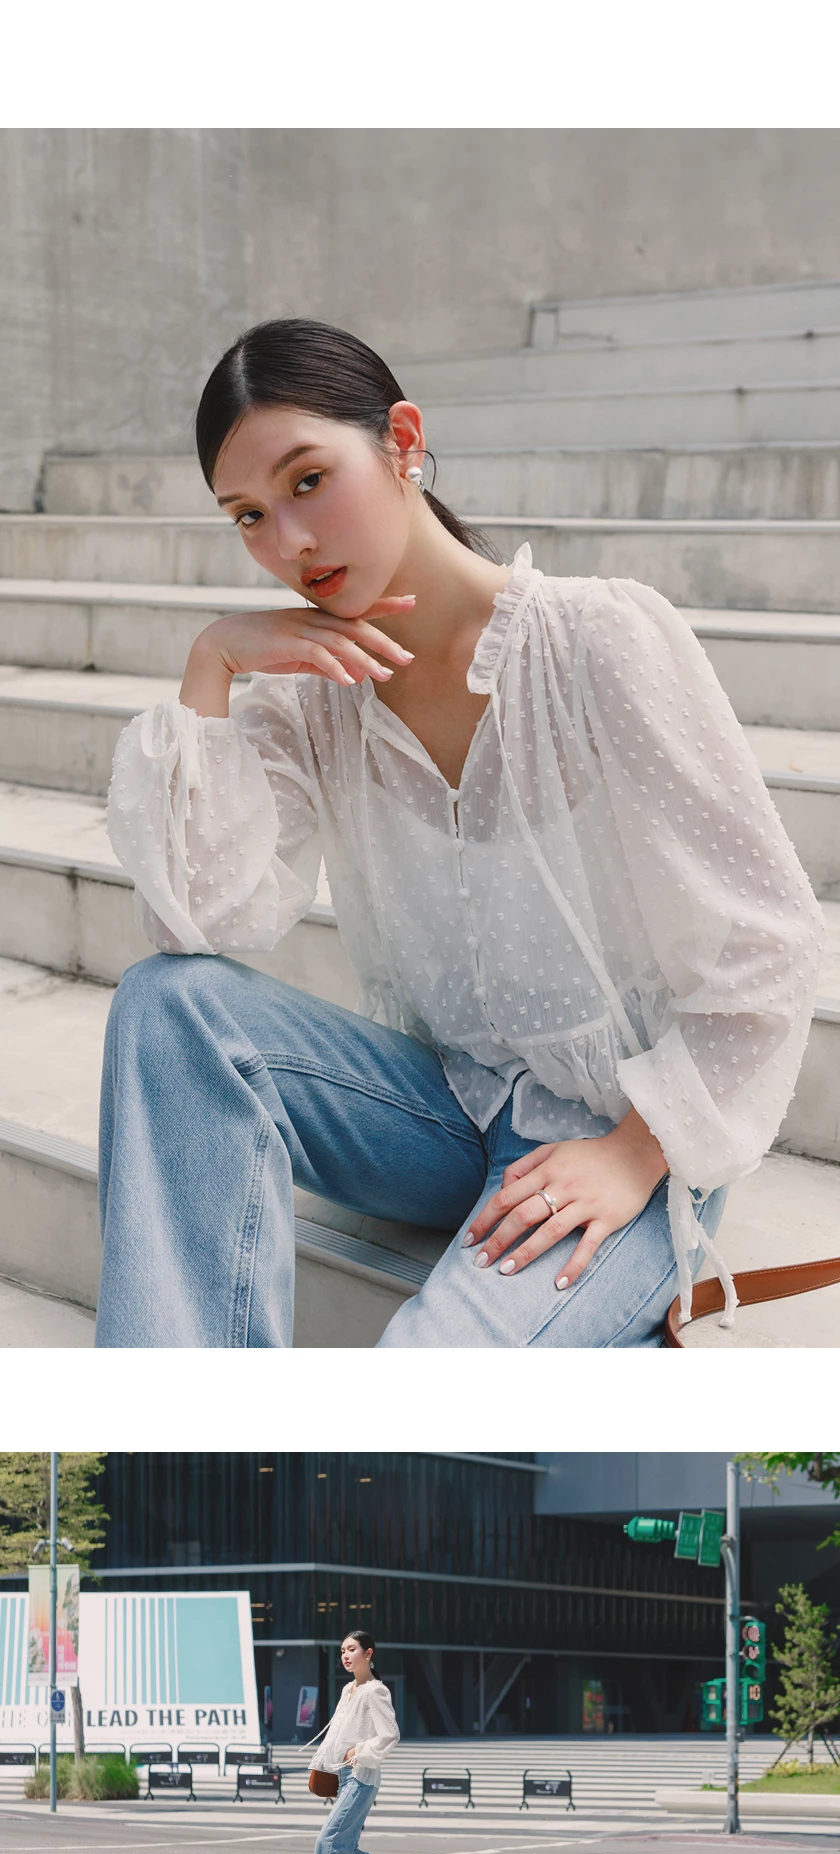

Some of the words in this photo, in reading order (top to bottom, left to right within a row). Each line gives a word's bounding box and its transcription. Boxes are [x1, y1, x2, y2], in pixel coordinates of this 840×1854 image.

[87, 1709, 138, 1727] LEAD
[146, 1709, 186, 1727] THE
[194, 1709, 247, 1726] PATH
